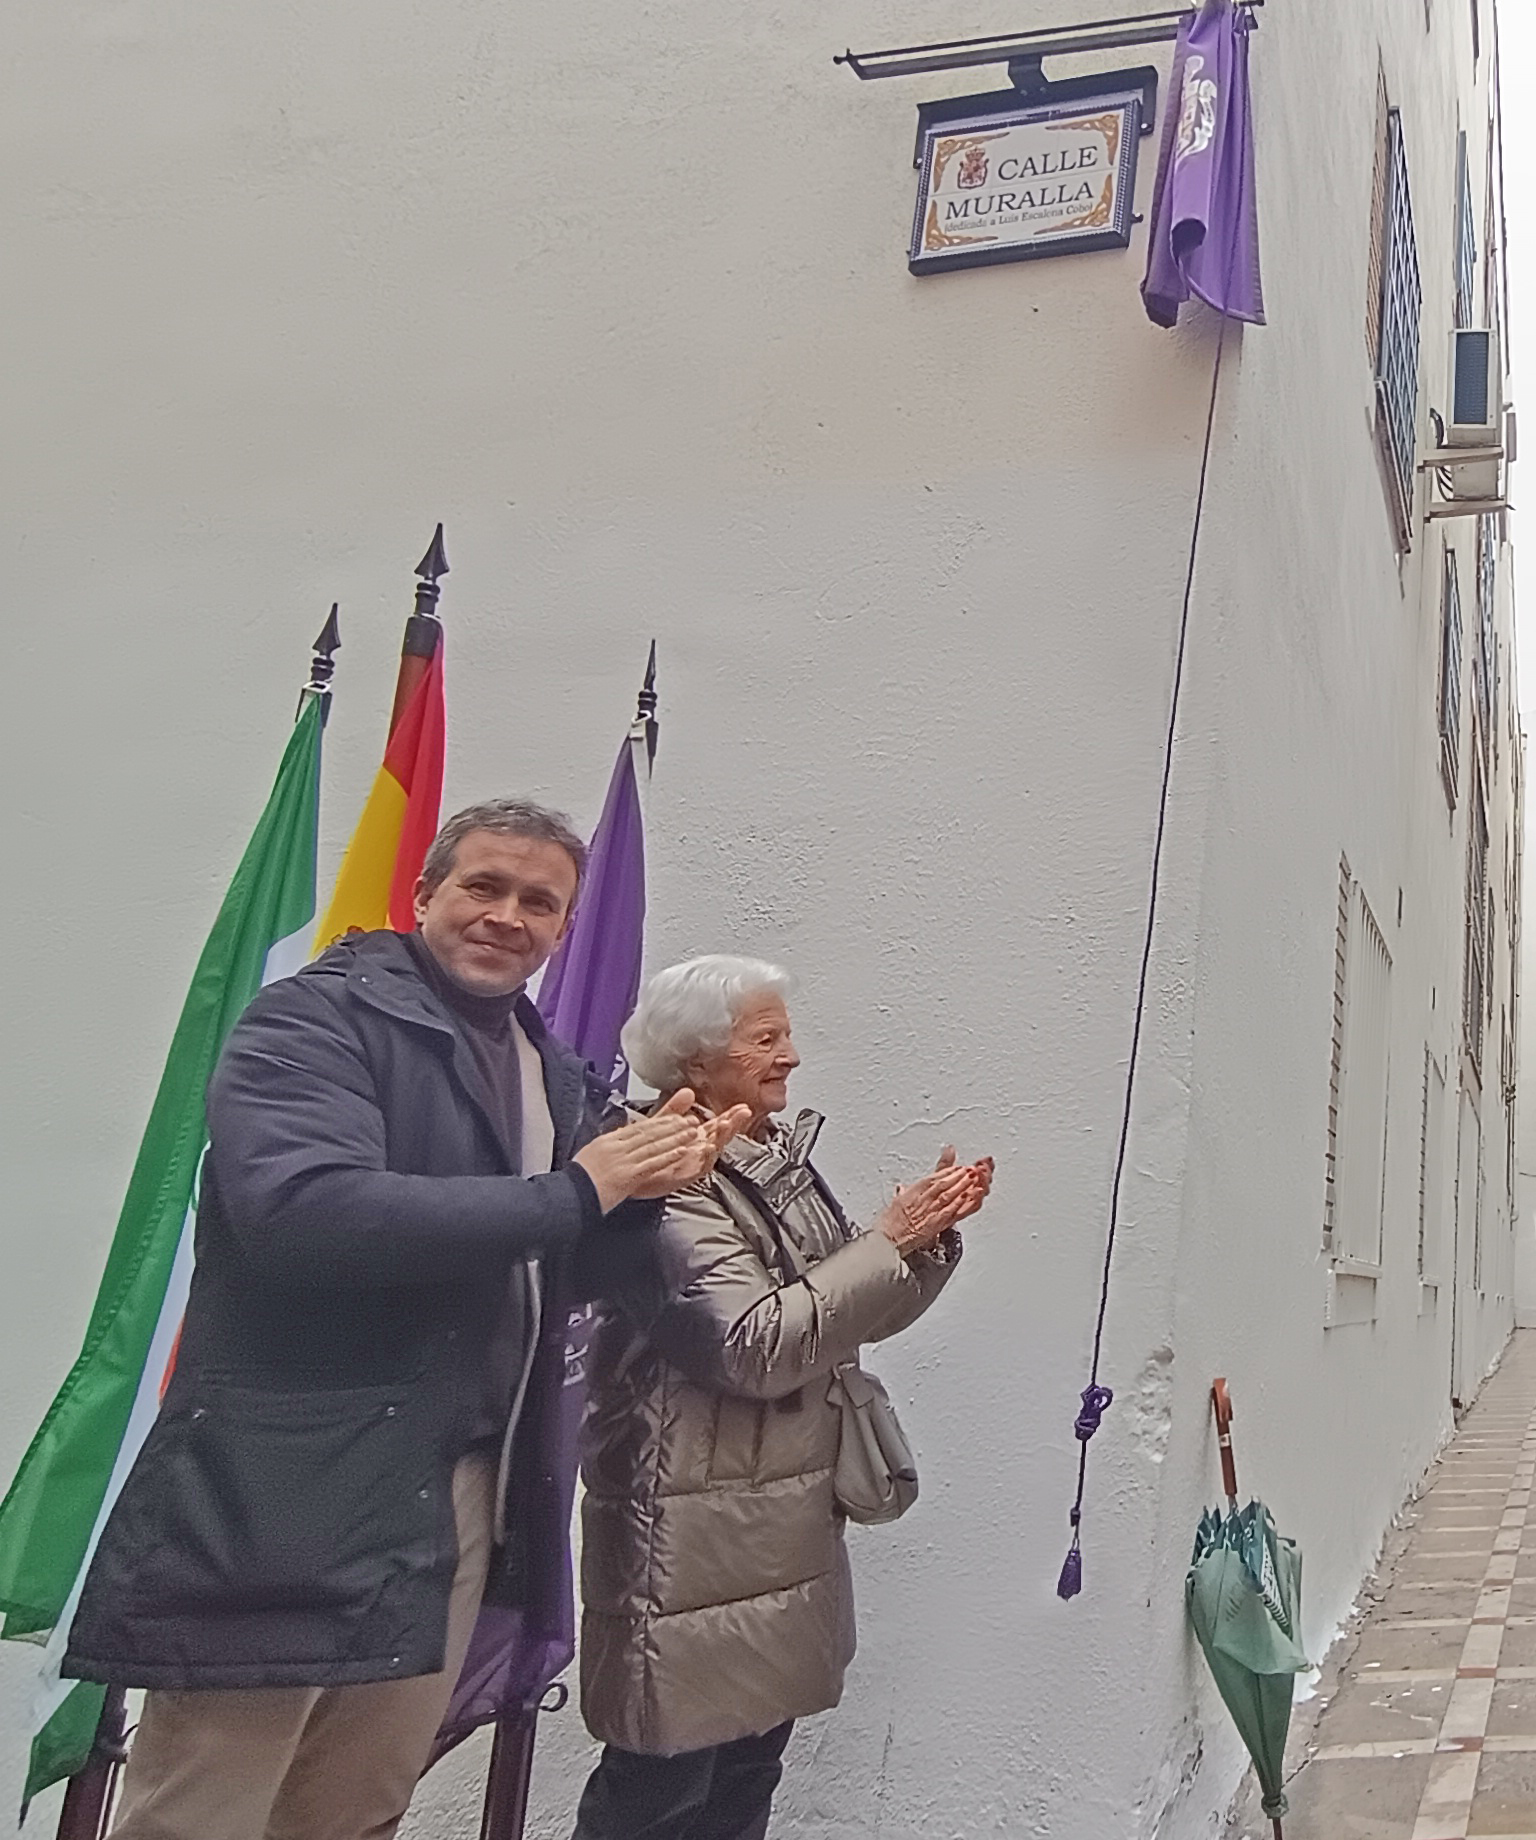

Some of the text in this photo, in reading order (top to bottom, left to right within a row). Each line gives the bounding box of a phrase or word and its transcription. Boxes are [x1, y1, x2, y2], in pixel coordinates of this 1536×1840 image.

[998, 145, 1098, 180] CALLE
[945, 181, 1094, 220] MURALLA
[999, 215, 1018, 225] Luis
[1022, 208, 1064, 222] Escalona
